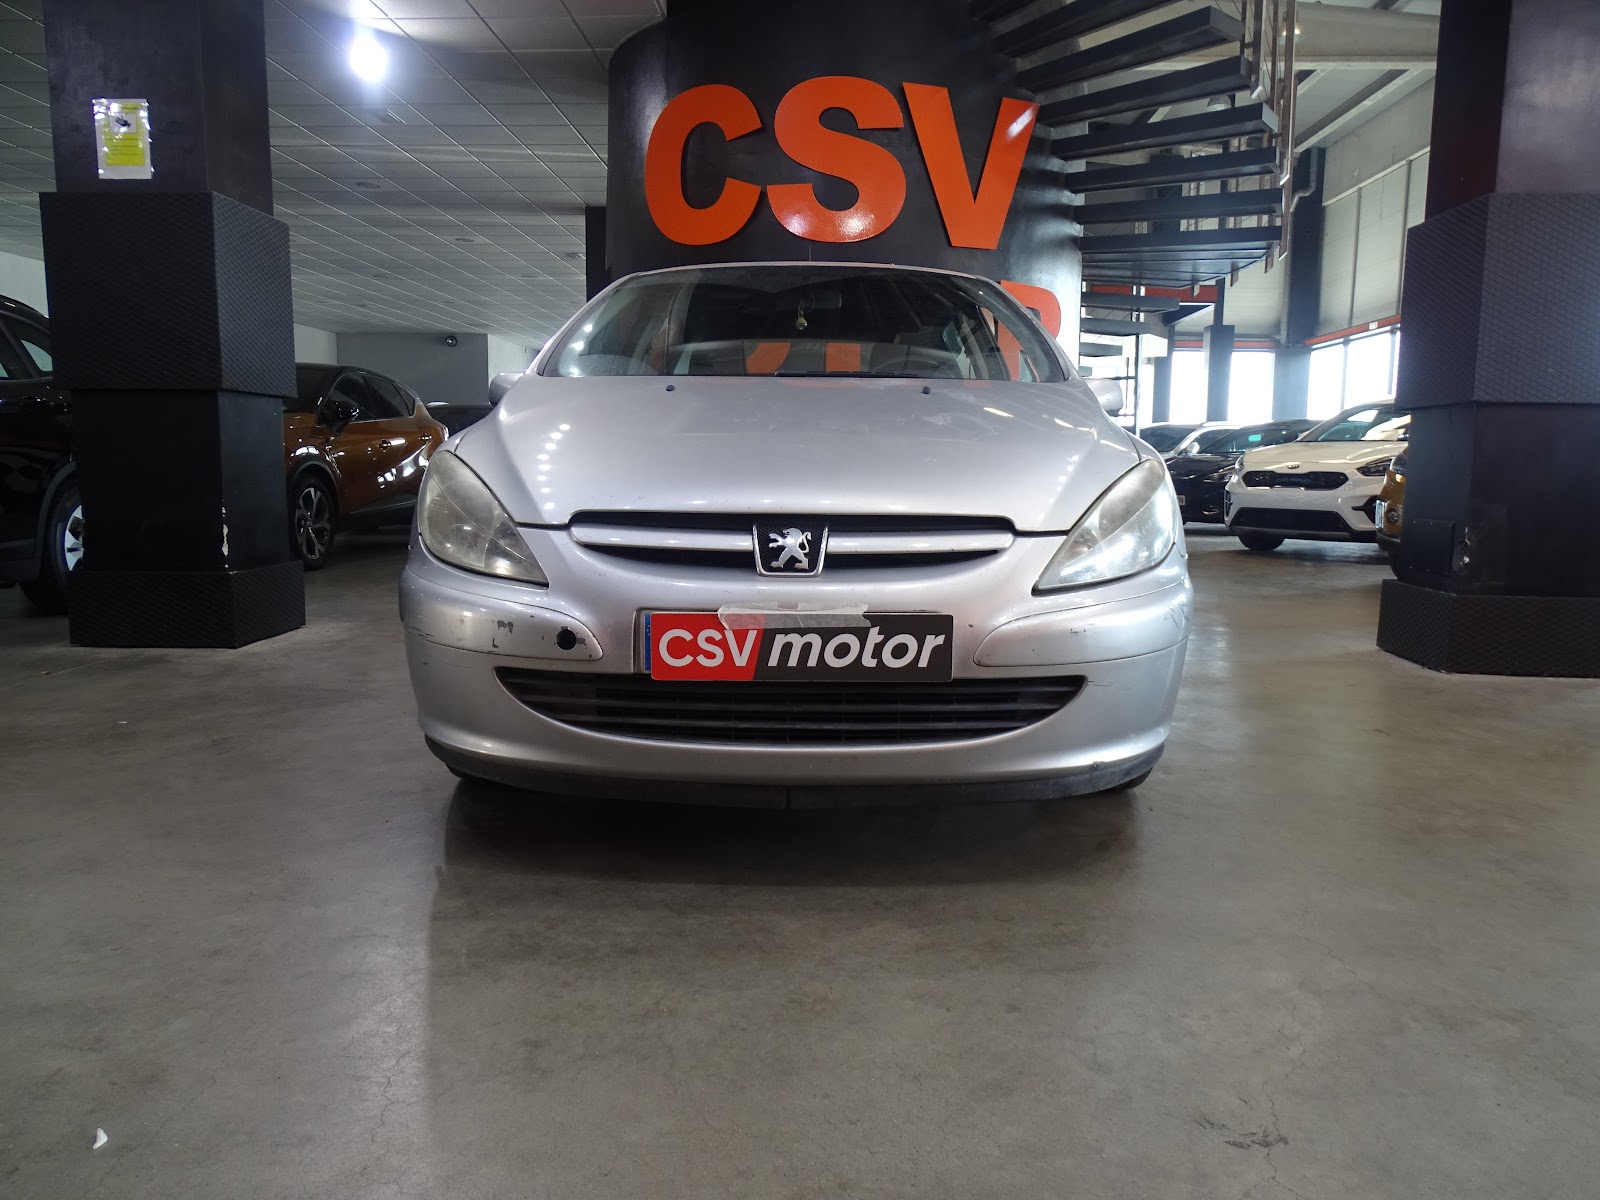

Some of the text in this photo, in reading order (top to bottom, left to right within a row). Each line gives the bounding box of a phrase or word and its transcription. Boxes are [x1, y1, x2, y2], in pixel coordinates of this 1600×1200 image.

[645, 76, 1040, 250] CSV
[658, 625, 946, 669] CSV motor
